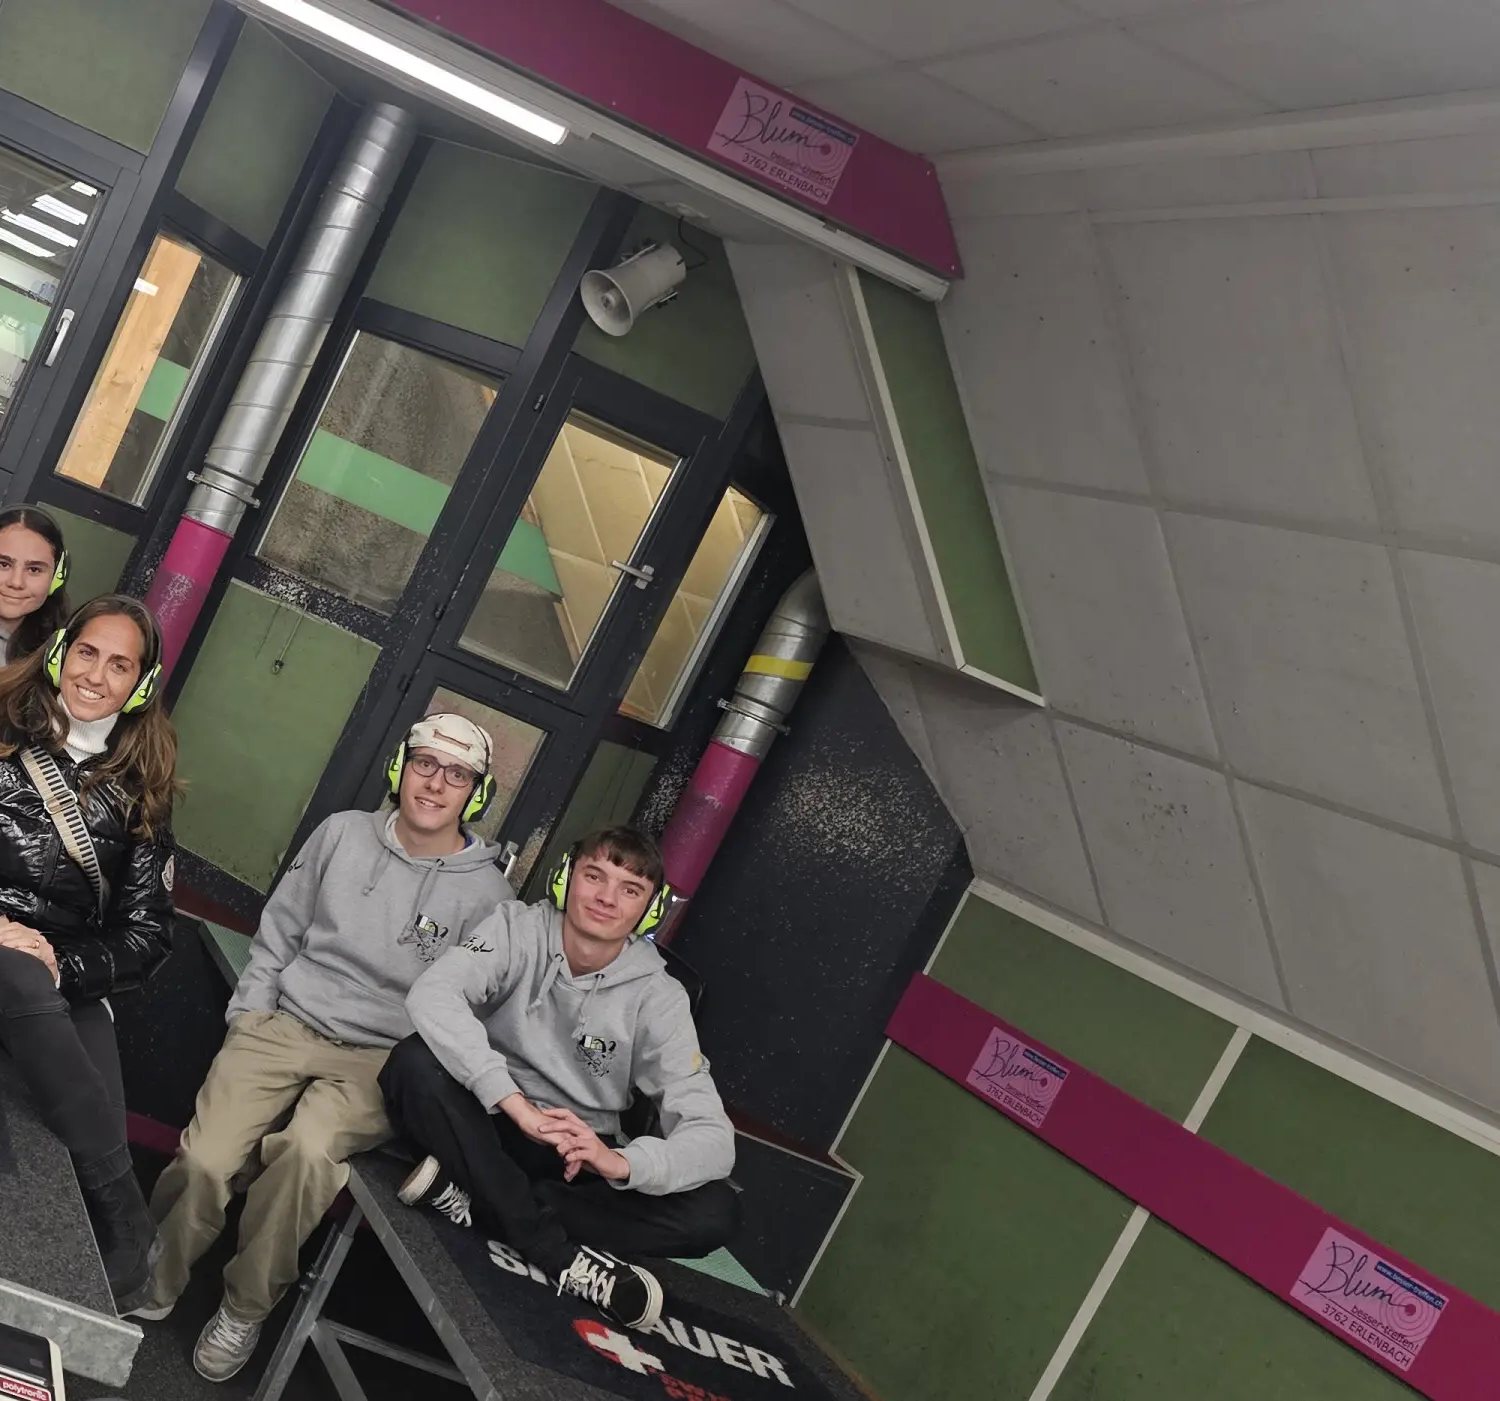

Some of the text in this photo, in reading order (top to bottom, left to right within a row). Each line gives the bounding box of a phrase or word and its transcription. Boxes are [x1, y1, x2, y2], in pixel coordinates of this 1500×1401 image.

[722, 90, 814, 147] Blum
[742, 153, 829, 199] 3762 ERLENBACH
[974, 1036, 1037, 1081] Blum
[986, 1085, 1042, 1124] 3762 ERLENBACH
[1301, 1241, 1397, 1304] Blum
[487, 1239, 550, 1286] SI
[636, 1316, 796, 1388] AUER
[1322, 1303, 1411, 1366] 3762 ERLENBACH
[1351, 1304, 1419, 1351] besser-treffen!
[3, 1381, 47, 1401] polytronic
